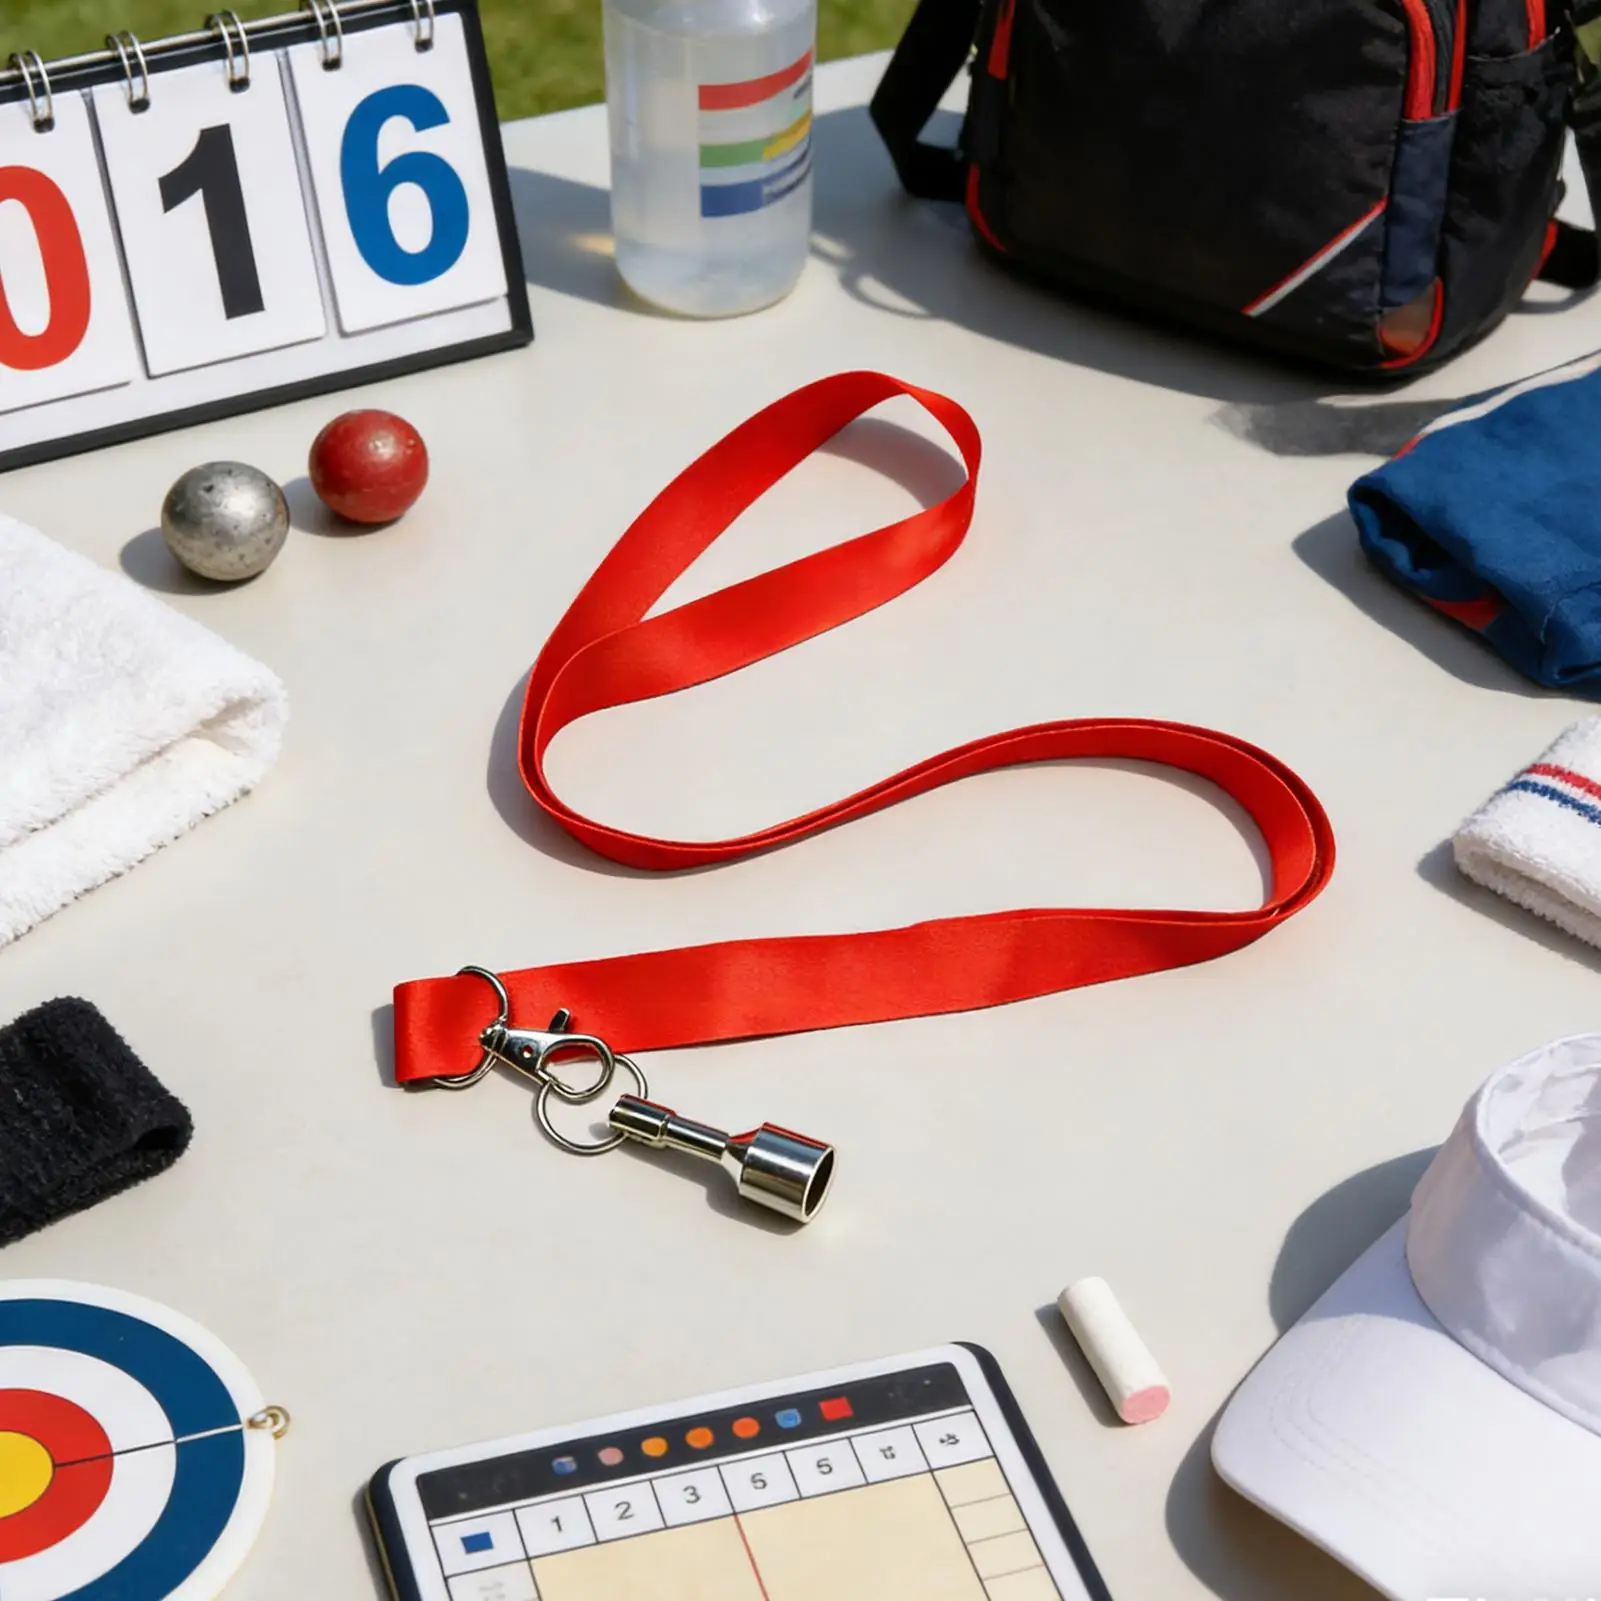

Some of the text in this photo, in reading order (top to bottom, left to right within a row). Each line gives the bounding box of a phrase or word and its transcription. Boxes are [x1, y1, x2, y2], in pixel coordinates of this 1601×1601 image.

[0, 84, 470, 372] 0 1 6
[551, 1515, 563, 1532] 1
[614, 1501, 634, 1521] 2
[682, 1485, 702, 1504] 3
